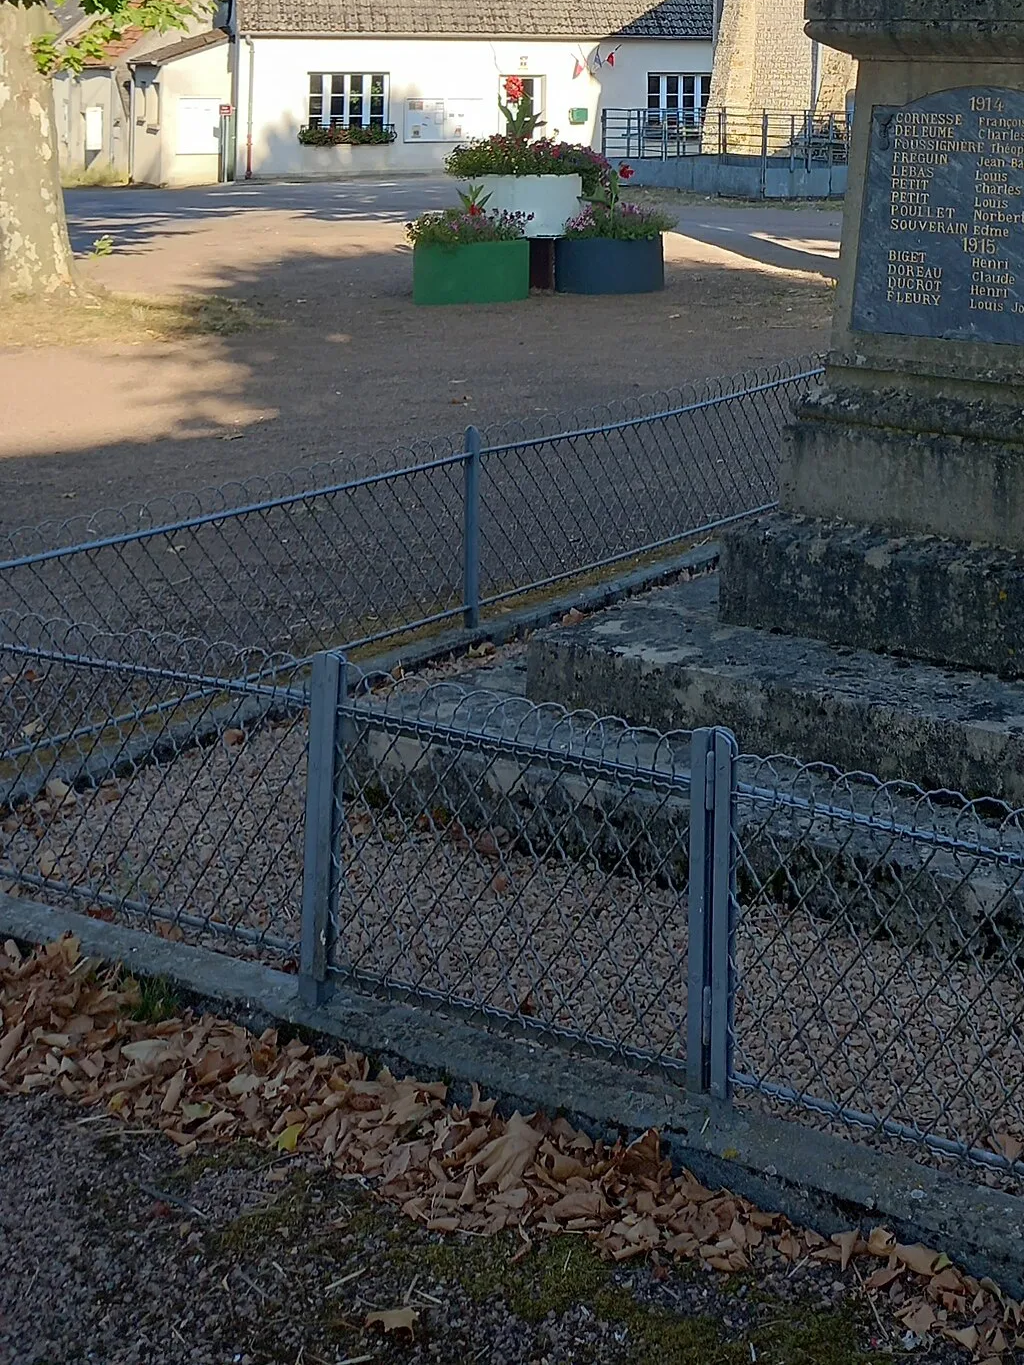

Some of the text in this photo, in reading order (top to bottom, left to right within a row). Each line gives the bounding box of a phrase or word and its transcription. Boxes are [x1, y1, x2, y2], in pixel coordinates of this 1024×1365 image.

[969, 96, 1005, 112] 1914
[895, 113, 963, 126] CORNESSE
[894, 125, 955, 138] DELEUME
[976, 156, 1006, 169] Jean
[891, 165, 1008, 182] LEBAS Louis
[891, 178, 1022, 195] PETIT Charles
[890, 191, 1008, 208] PETIT Louis
[890, 205, 956, 218] POULLET
[890, 219, 1009, 237] SOUVERAIN Edme
[962, 237, 996, 254] 1915
[888, 250, 1009, 270] BIGET Henri
[887, 264, 943, 278] DOREAU
[971, 272, 1015, 285] Claude
[887, 277, 1009, 298] DUCROT Henri
[886, 291, 941, 306] FLEURY
[969, 299, 1004, 312] Louis
